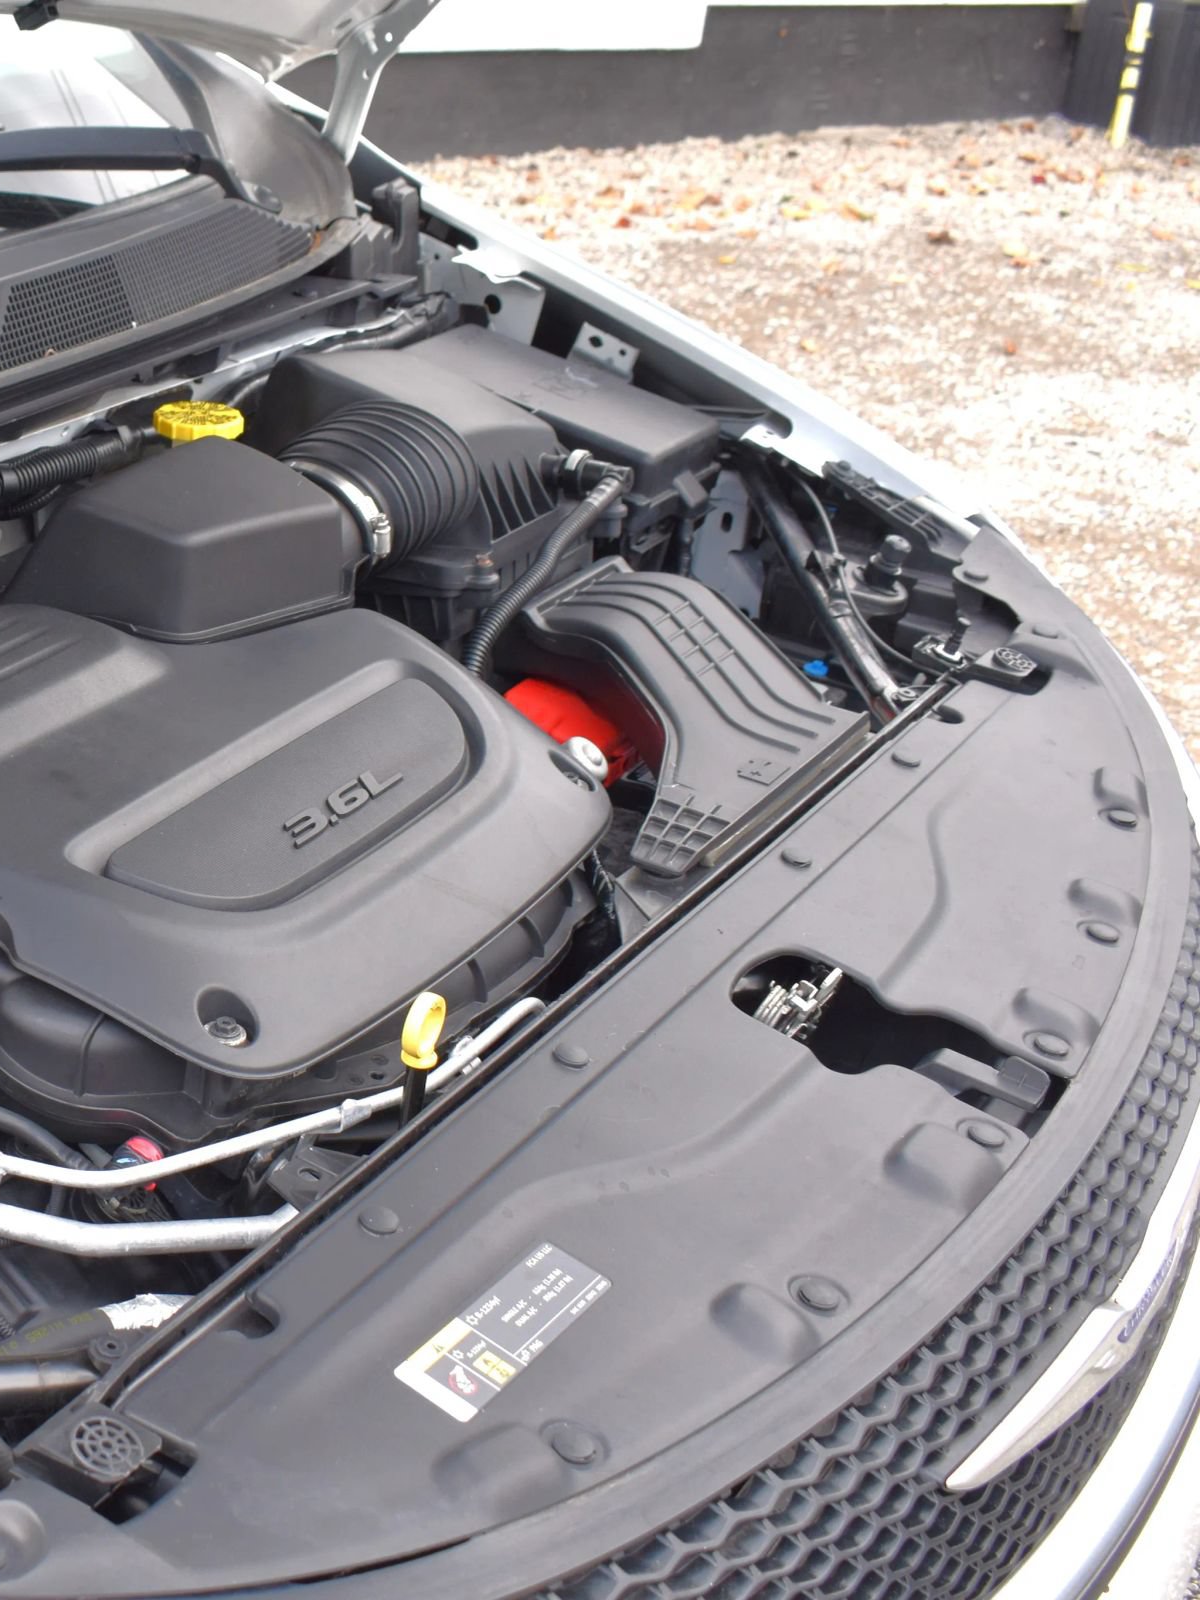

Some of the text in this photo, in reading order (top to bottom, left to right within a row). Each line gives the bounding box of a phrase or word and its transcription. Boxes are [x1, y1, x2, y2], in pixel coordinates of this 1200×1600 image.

[283, 770, 403, 849] 3.6L
[525, 1244, 553, 1267] FCA US LLC
[529, 1339, 544, 1352] PAG
